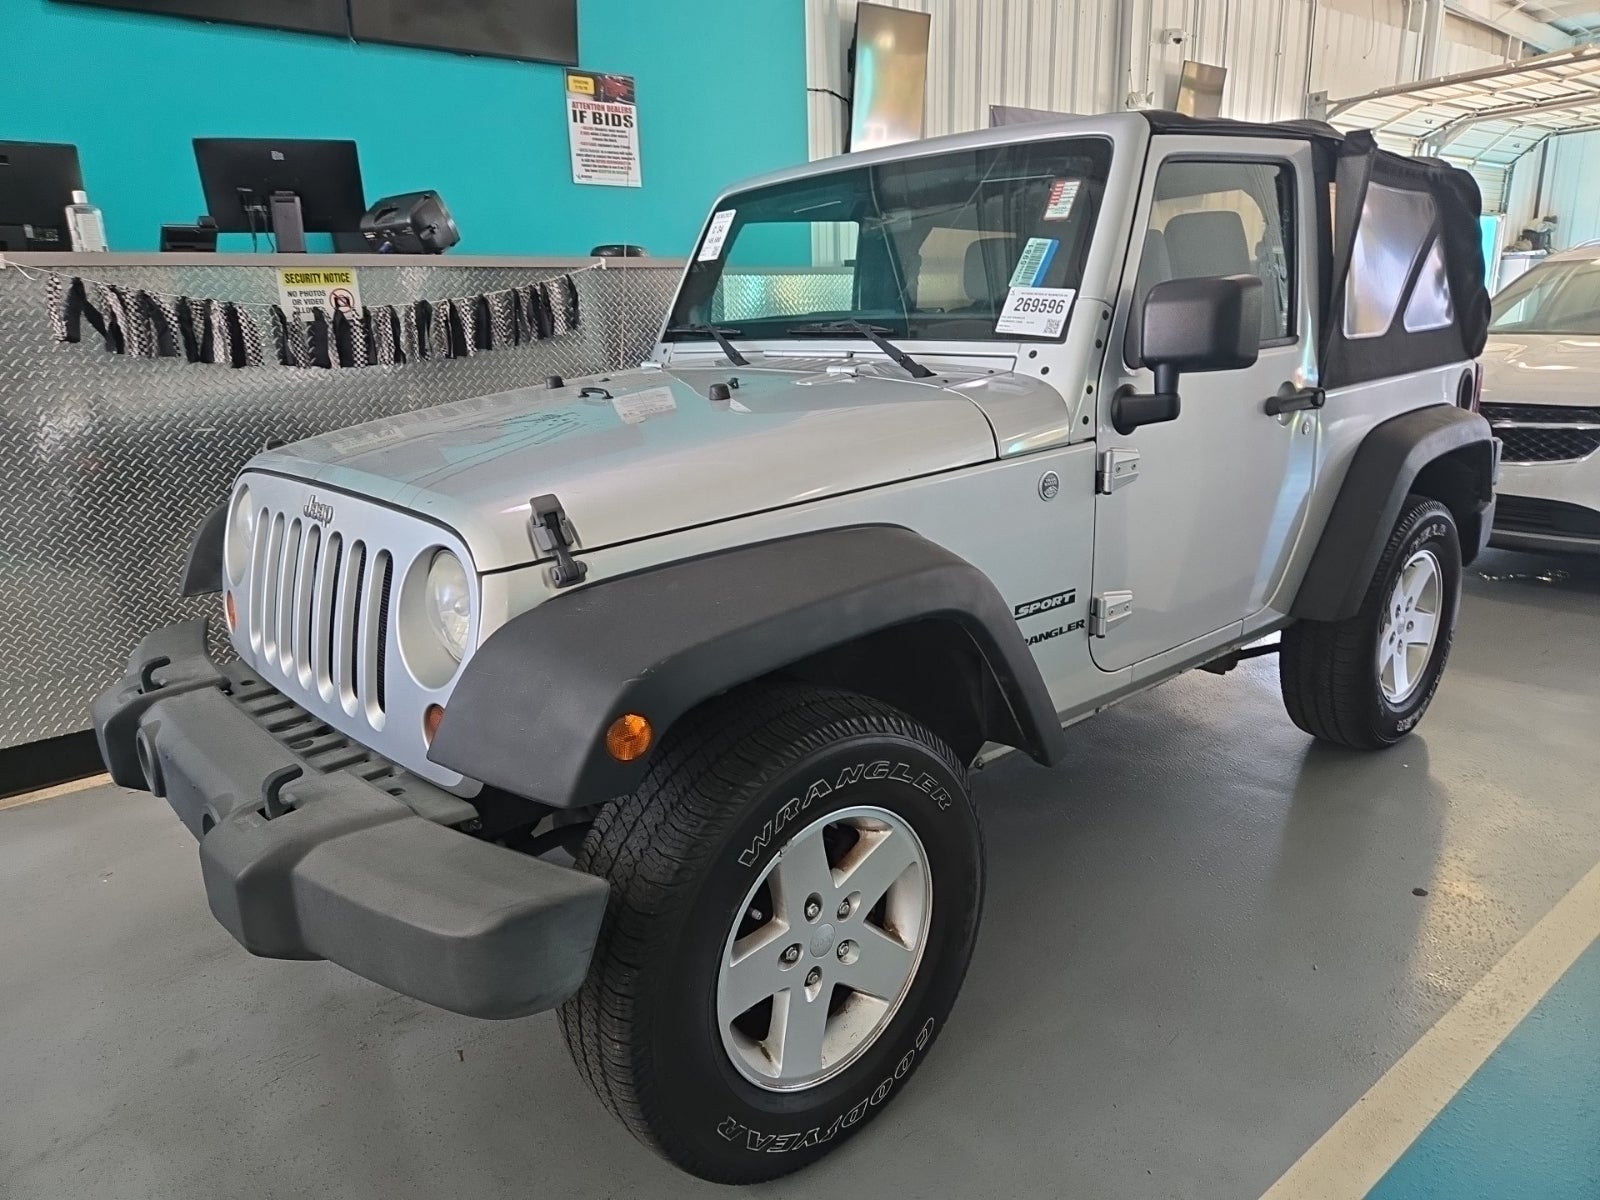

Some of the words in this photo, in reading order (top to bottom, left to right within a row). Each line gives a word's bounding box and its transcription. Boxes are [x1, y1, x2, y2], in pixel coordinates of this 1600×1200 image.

[572, 101, 605, 111] ATTENTION
[606, 104, 632, 114] DEALERS
[572, 109, 587, 124] IF
[592, 112, 633, 128] BIDS
[285, 273, 321, 284] SECURITY
[323, 273, 350, 283] NOTICE
[1013, 297, 1066, 315] 269596
[303, 495, 333, 528] Jeep
[1016, 591, 1075, 619] SPORT
[1024, 619, 1085, 646] ANGLER
[737, 760, 952, 868] WRANGLER
[717, 1017, 935, 1153] GOODYEAR
